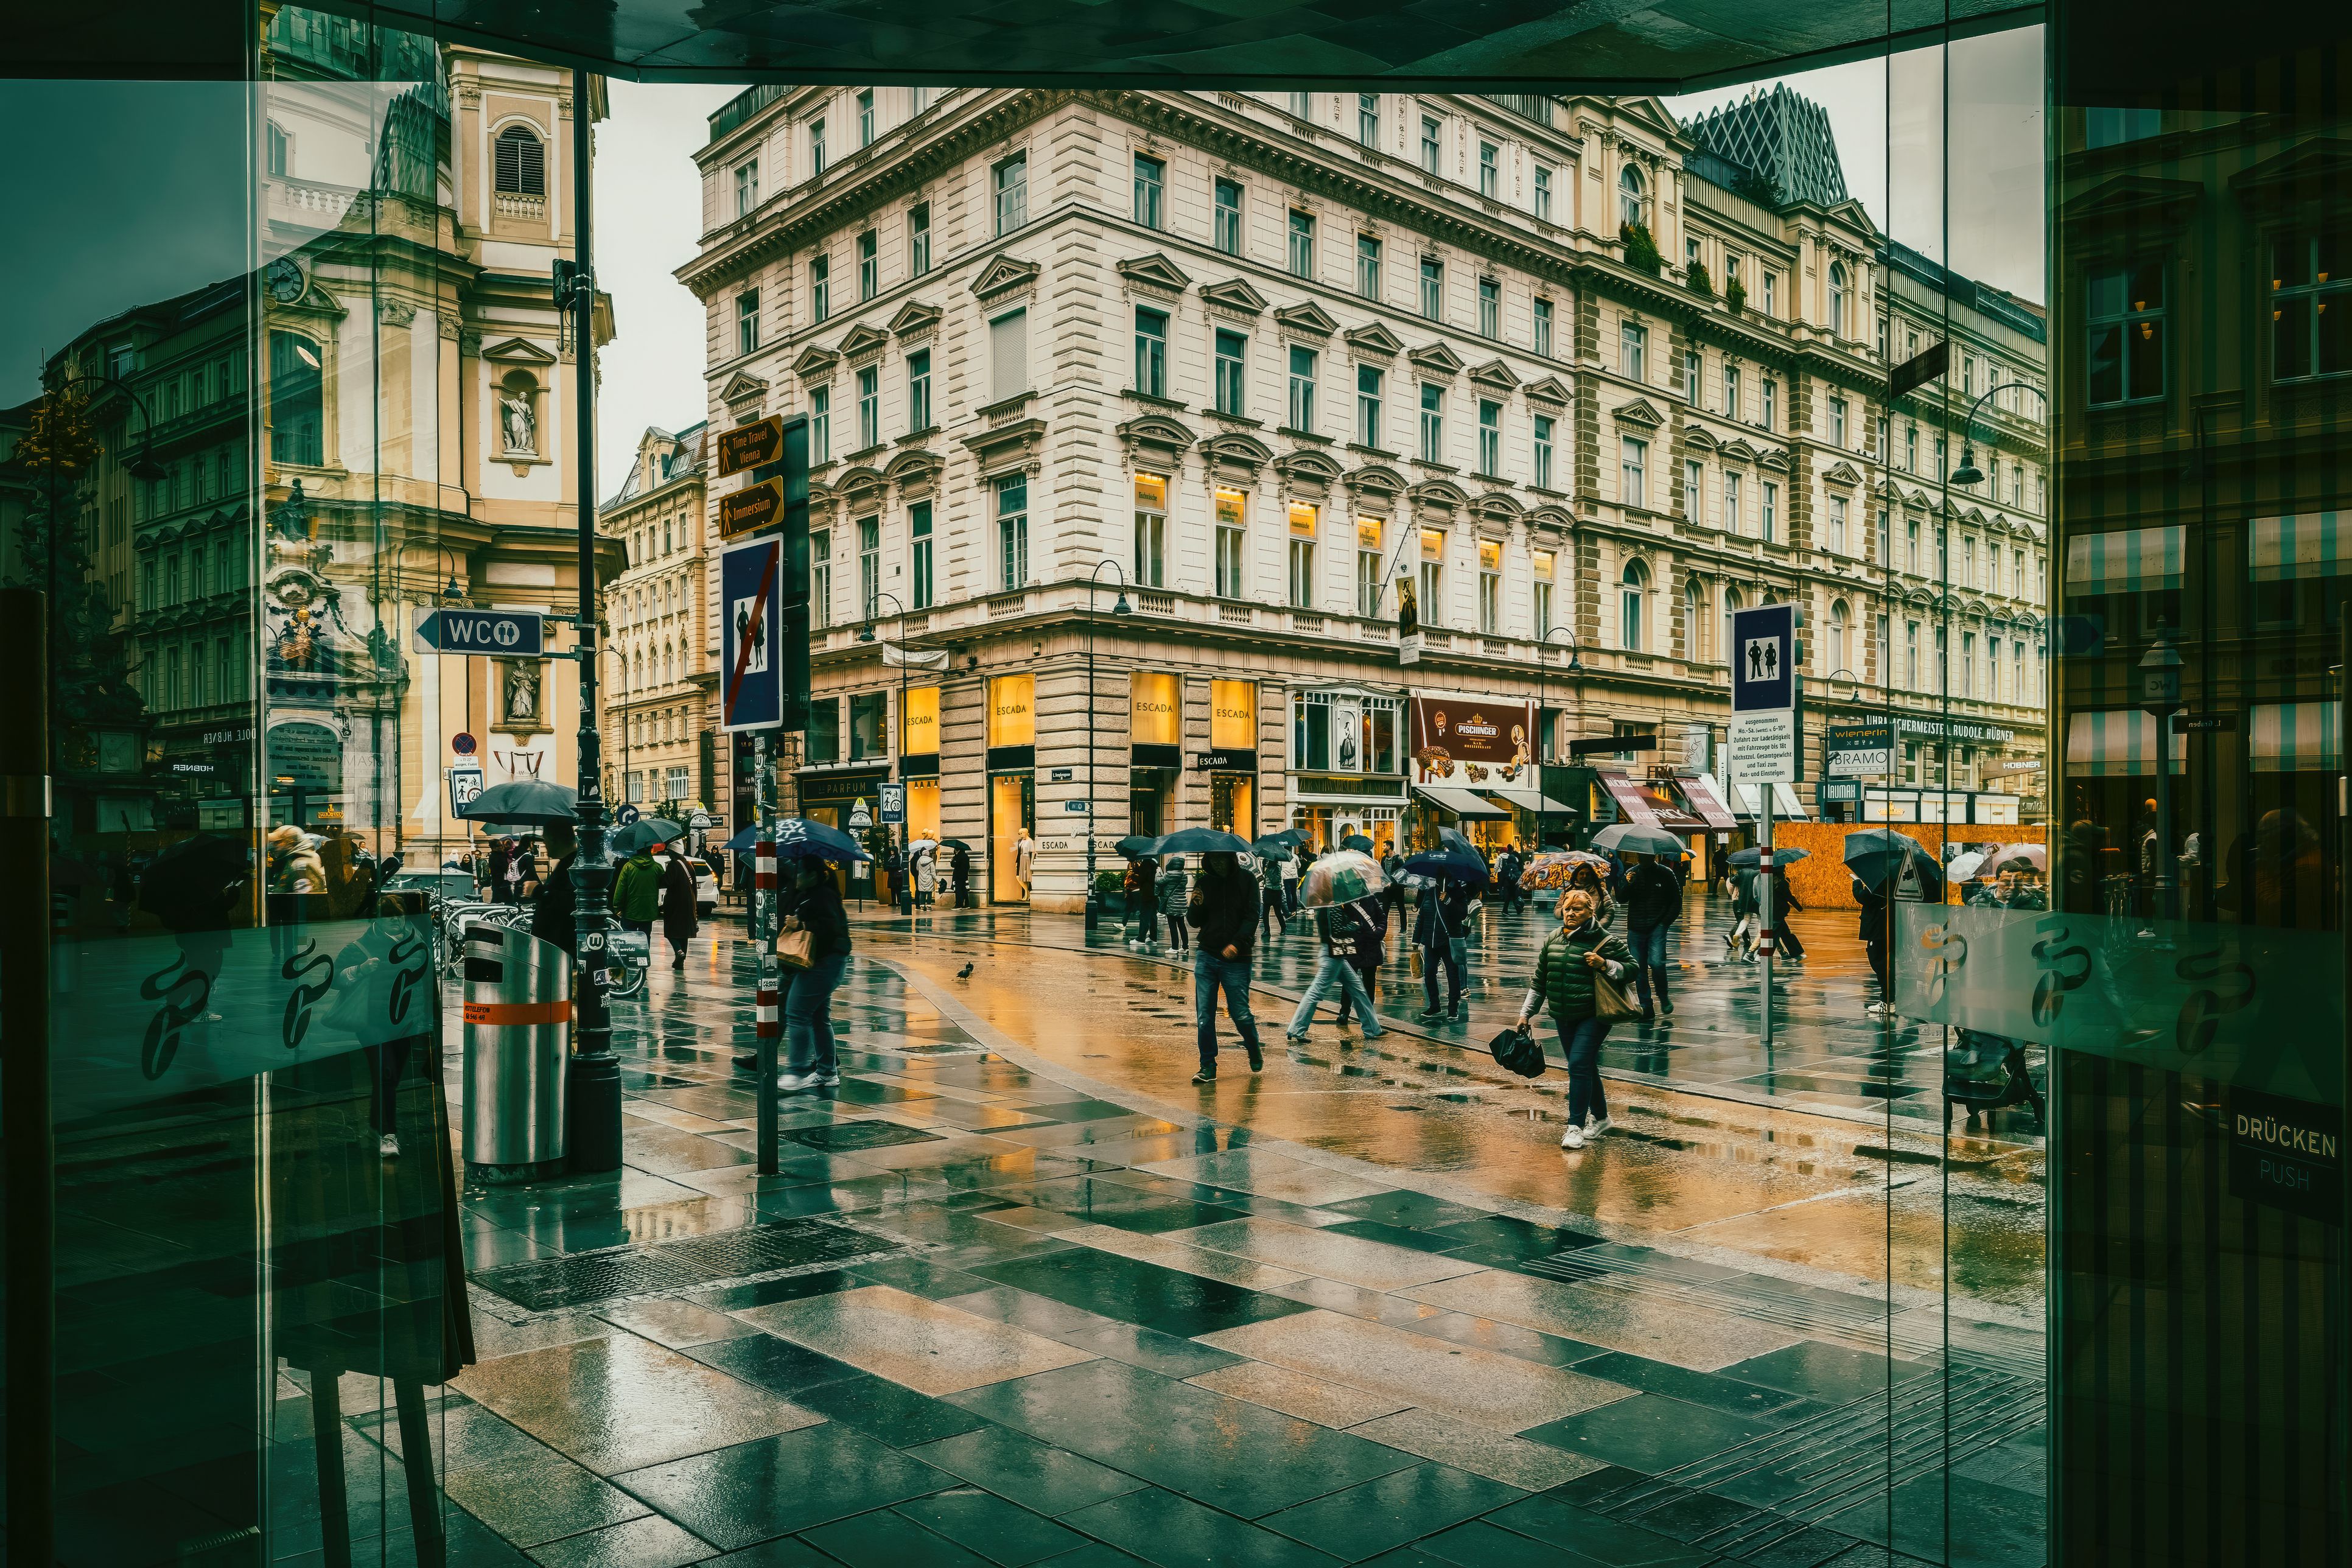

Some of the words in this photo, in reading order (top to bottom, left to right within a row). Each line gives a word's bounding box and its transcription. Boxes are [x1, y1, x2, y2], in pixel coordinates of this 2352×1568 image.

[732, 436, 747, 450] Time
[749, 427, 767, 444] Travel
[740, 450, 760, 464] Vienna
[733, 499, 770, 520] Immersium
[449, 618, 491, 643] WC
[997, 705, 1026, 716] ESCADA
[1137, 702, 1173, 713] ESCADA
[1217, 709, 1250, 719] ESCADA
[907, 716, 933, 726] ESCADA
[1986, 726, 2014, 742] HÜBNER
[1684, 738, 1702, 763] FRICK
[1200, 757, 1228, 765] ESCADA
[827, 782, 866, 793] PARFUM
[2238, 1114, 2335, 1158] DRÜCKEN
[2261, 1159, 2309, 1191] PUSH
